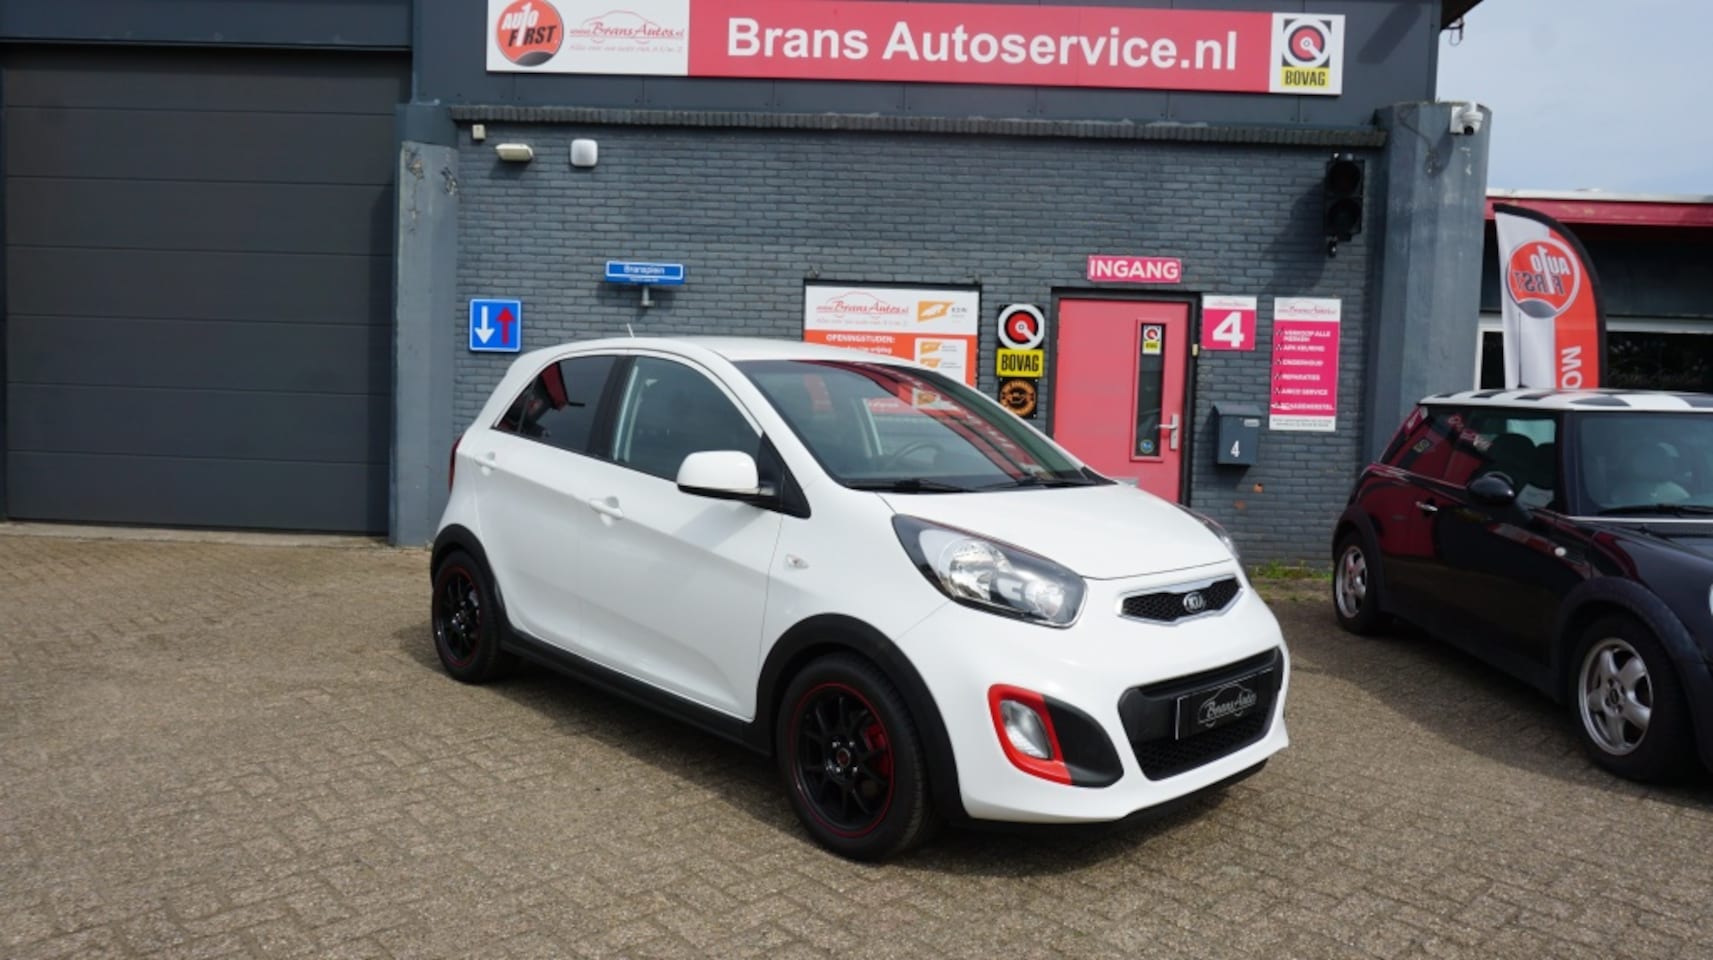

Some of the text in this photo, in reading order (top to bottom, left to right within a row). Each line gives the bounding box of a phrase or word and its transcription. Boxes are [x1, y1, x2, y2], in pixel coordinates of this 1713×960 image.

[508, 25, 557, 48] FIRST
[727, 17, 1238, 71] Brans Autoservice.nl
[1284, 69, 1327, 87] BOVAG
[1089, 259, 1179, 279] INGANG
[1212, 311, 1245, 348] 4
[1001, 353, 1040, 372] BOVAG
[1230, 440, 1241, 458] 4
